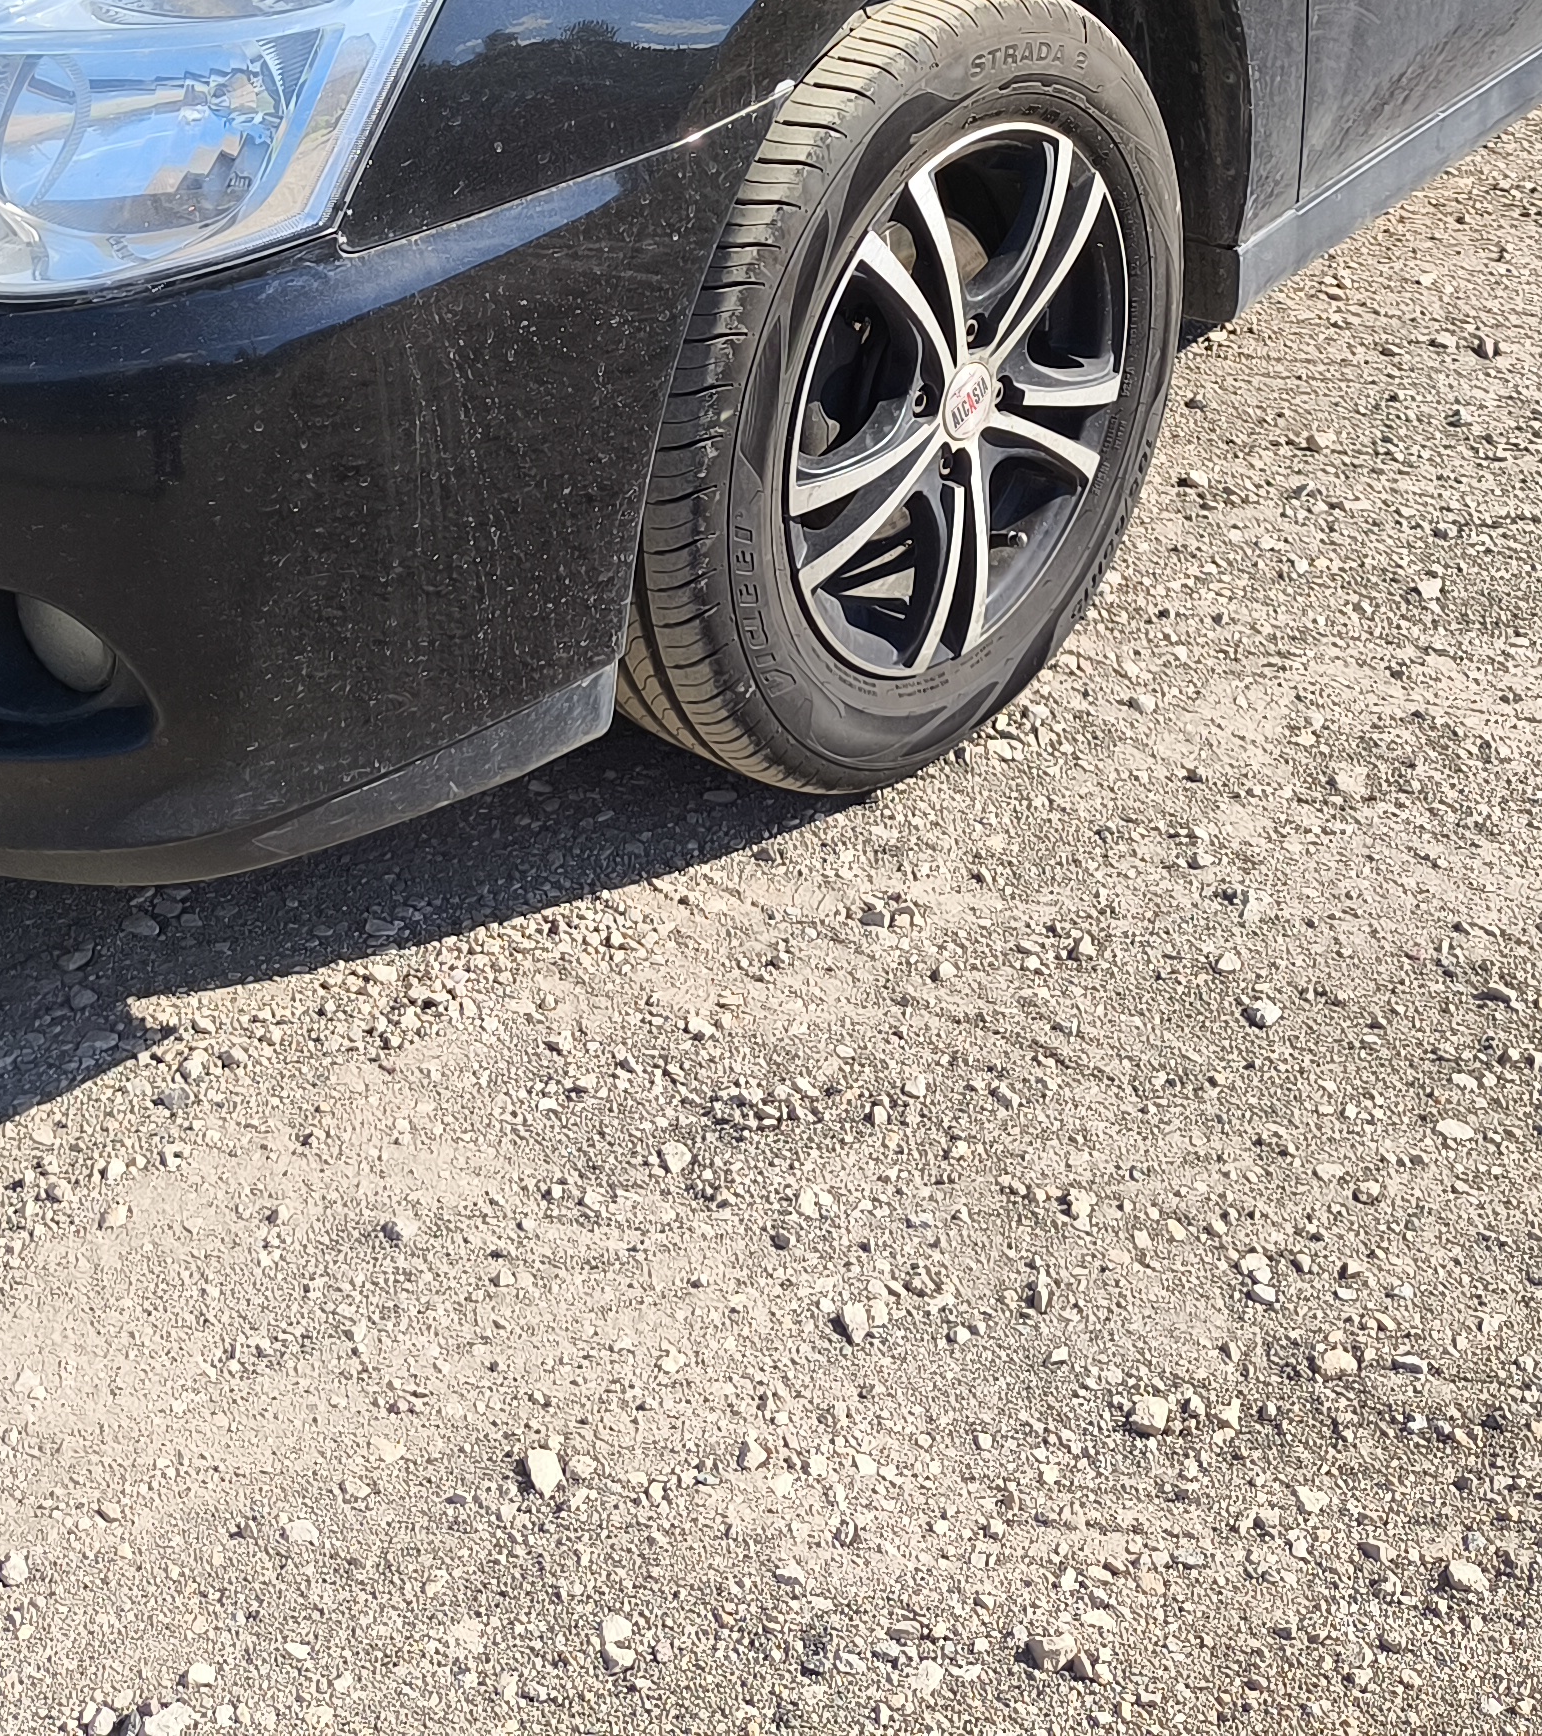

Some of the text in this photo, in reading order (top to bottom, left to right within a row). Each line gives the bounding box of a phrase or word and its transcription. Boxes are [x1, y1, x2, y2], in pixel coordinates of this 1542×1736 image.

[969, 41, 1090, 78] STRADA 2
[950, 375, 990, 430] ALCASTA
